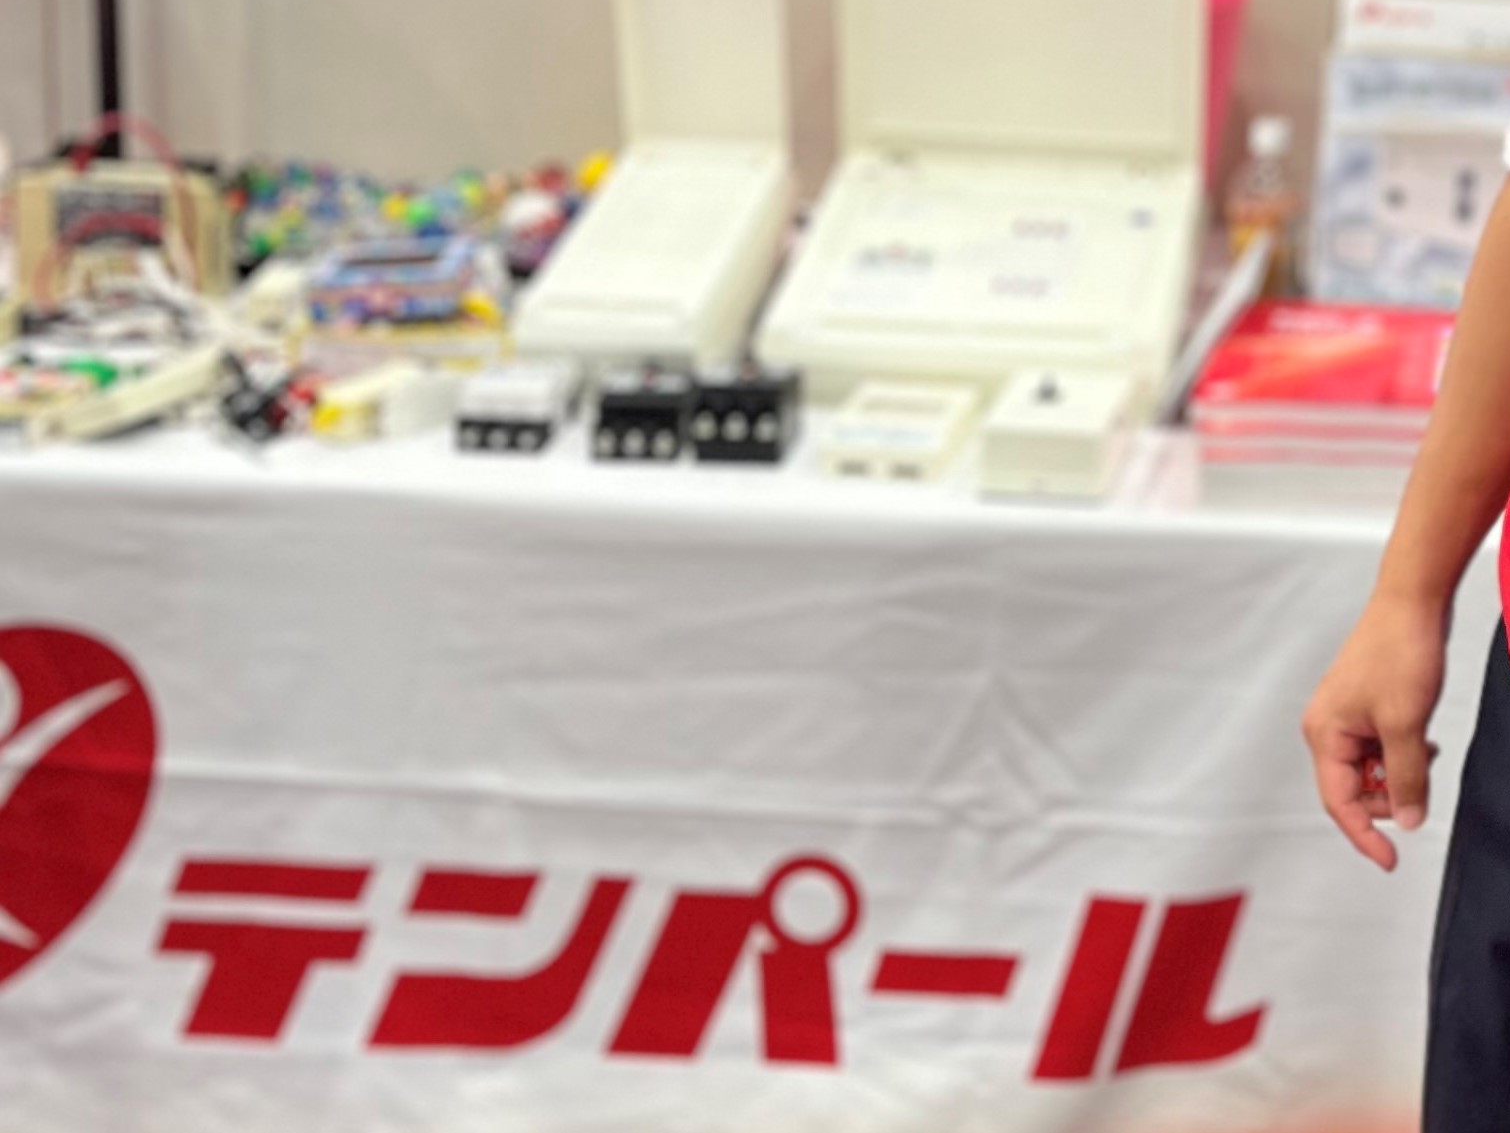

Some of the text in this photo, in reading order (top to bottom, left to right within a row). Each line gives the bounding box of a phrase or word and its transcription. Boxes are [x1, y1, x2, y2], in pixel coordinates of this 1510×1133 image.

[151, 850, 1272, 1085] テンパール
